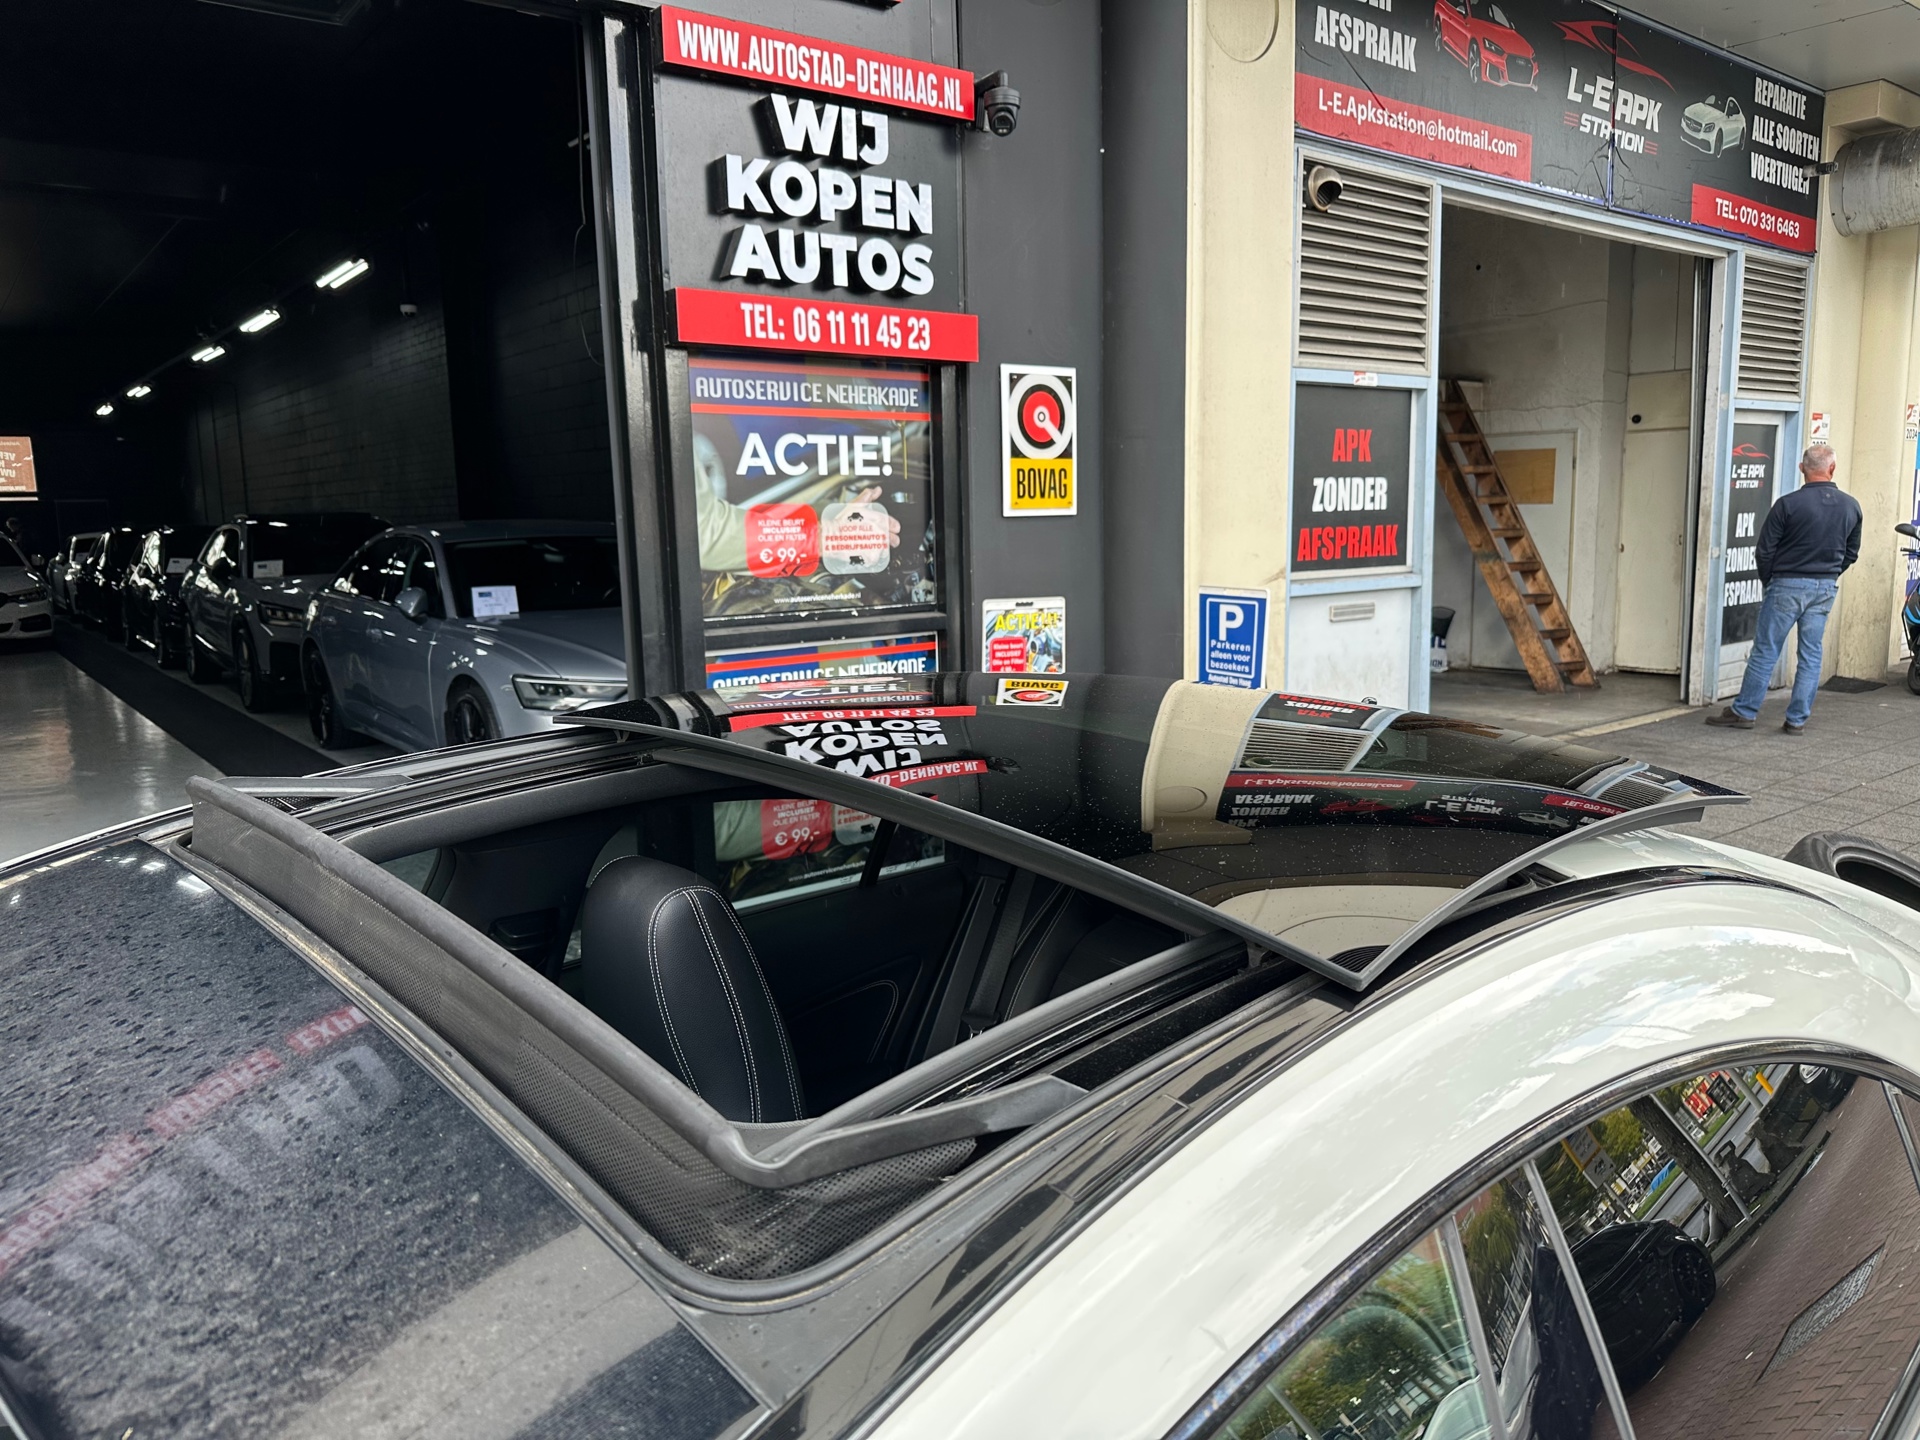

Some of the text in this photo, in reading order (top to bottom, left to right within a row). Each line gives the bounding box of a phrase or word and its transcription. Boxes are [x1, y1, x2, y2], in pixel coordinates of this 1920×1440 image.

[1314, 5, 1417, 73] AFSPRAAK
[677, 20, 965, 112] WWW.AUTOSTAD-DENHAAG.NL
[1567, 67, 1662, 133] L-E APK
[1754, 77, 1807, 121] REPARATIE
[770, 93, 889, 165] WIJ
[1318, 88, 1518, 158] L-E.Apkstation@hotmail.com
[1579, 112, 1645, 154] STATION
[1752, 115, 1820, 162] ALLE SOORTEN
[725, 154, 933, 234] KOPEN
[1715, 198, 1800, 239] TEL: 070 331 6463
[730, 224, 934, 296] AUTOS
[740, 302, 931, 352] TEL: 06 11 11 45 23
[696, 376, 919, 407] AUTOSERVICE NEHERKADE
[736, 432, 893, 477] ACTIE!
[1332, 428, 1373, 462] APK
[1017, 468, 1068, 499] BOVAG
[1735, 480, 1759, 489] STATION
[1748, 464, 1765, 478] APK
[1311, 476, 1389, 513] ZONDER
[758, 518, 805, 527] KLEINE BEURT
[762, 526, 802, 534] INCLUSIEF
[785, 533, 807, 541] FILTER
[1735, 512, 1755, 537] APK
[760, 547, 807, 564] € 99,-
[1297, 524, 1399, 562] AFSPRAAK
[1218, 603, 1245, 641] P
[1210, 639, 1251, 652] Parkeren
[1210, 650, 1251, 662] alleen voor
[1210, 660, 1250, 673] bezoekers
[777, 806, 815, 818] INCLUSIEF
[789, 816, 799, 824] EN
[800, 812, 820, 823] FILTER
[775, 827, 820, 846] € 99,-
